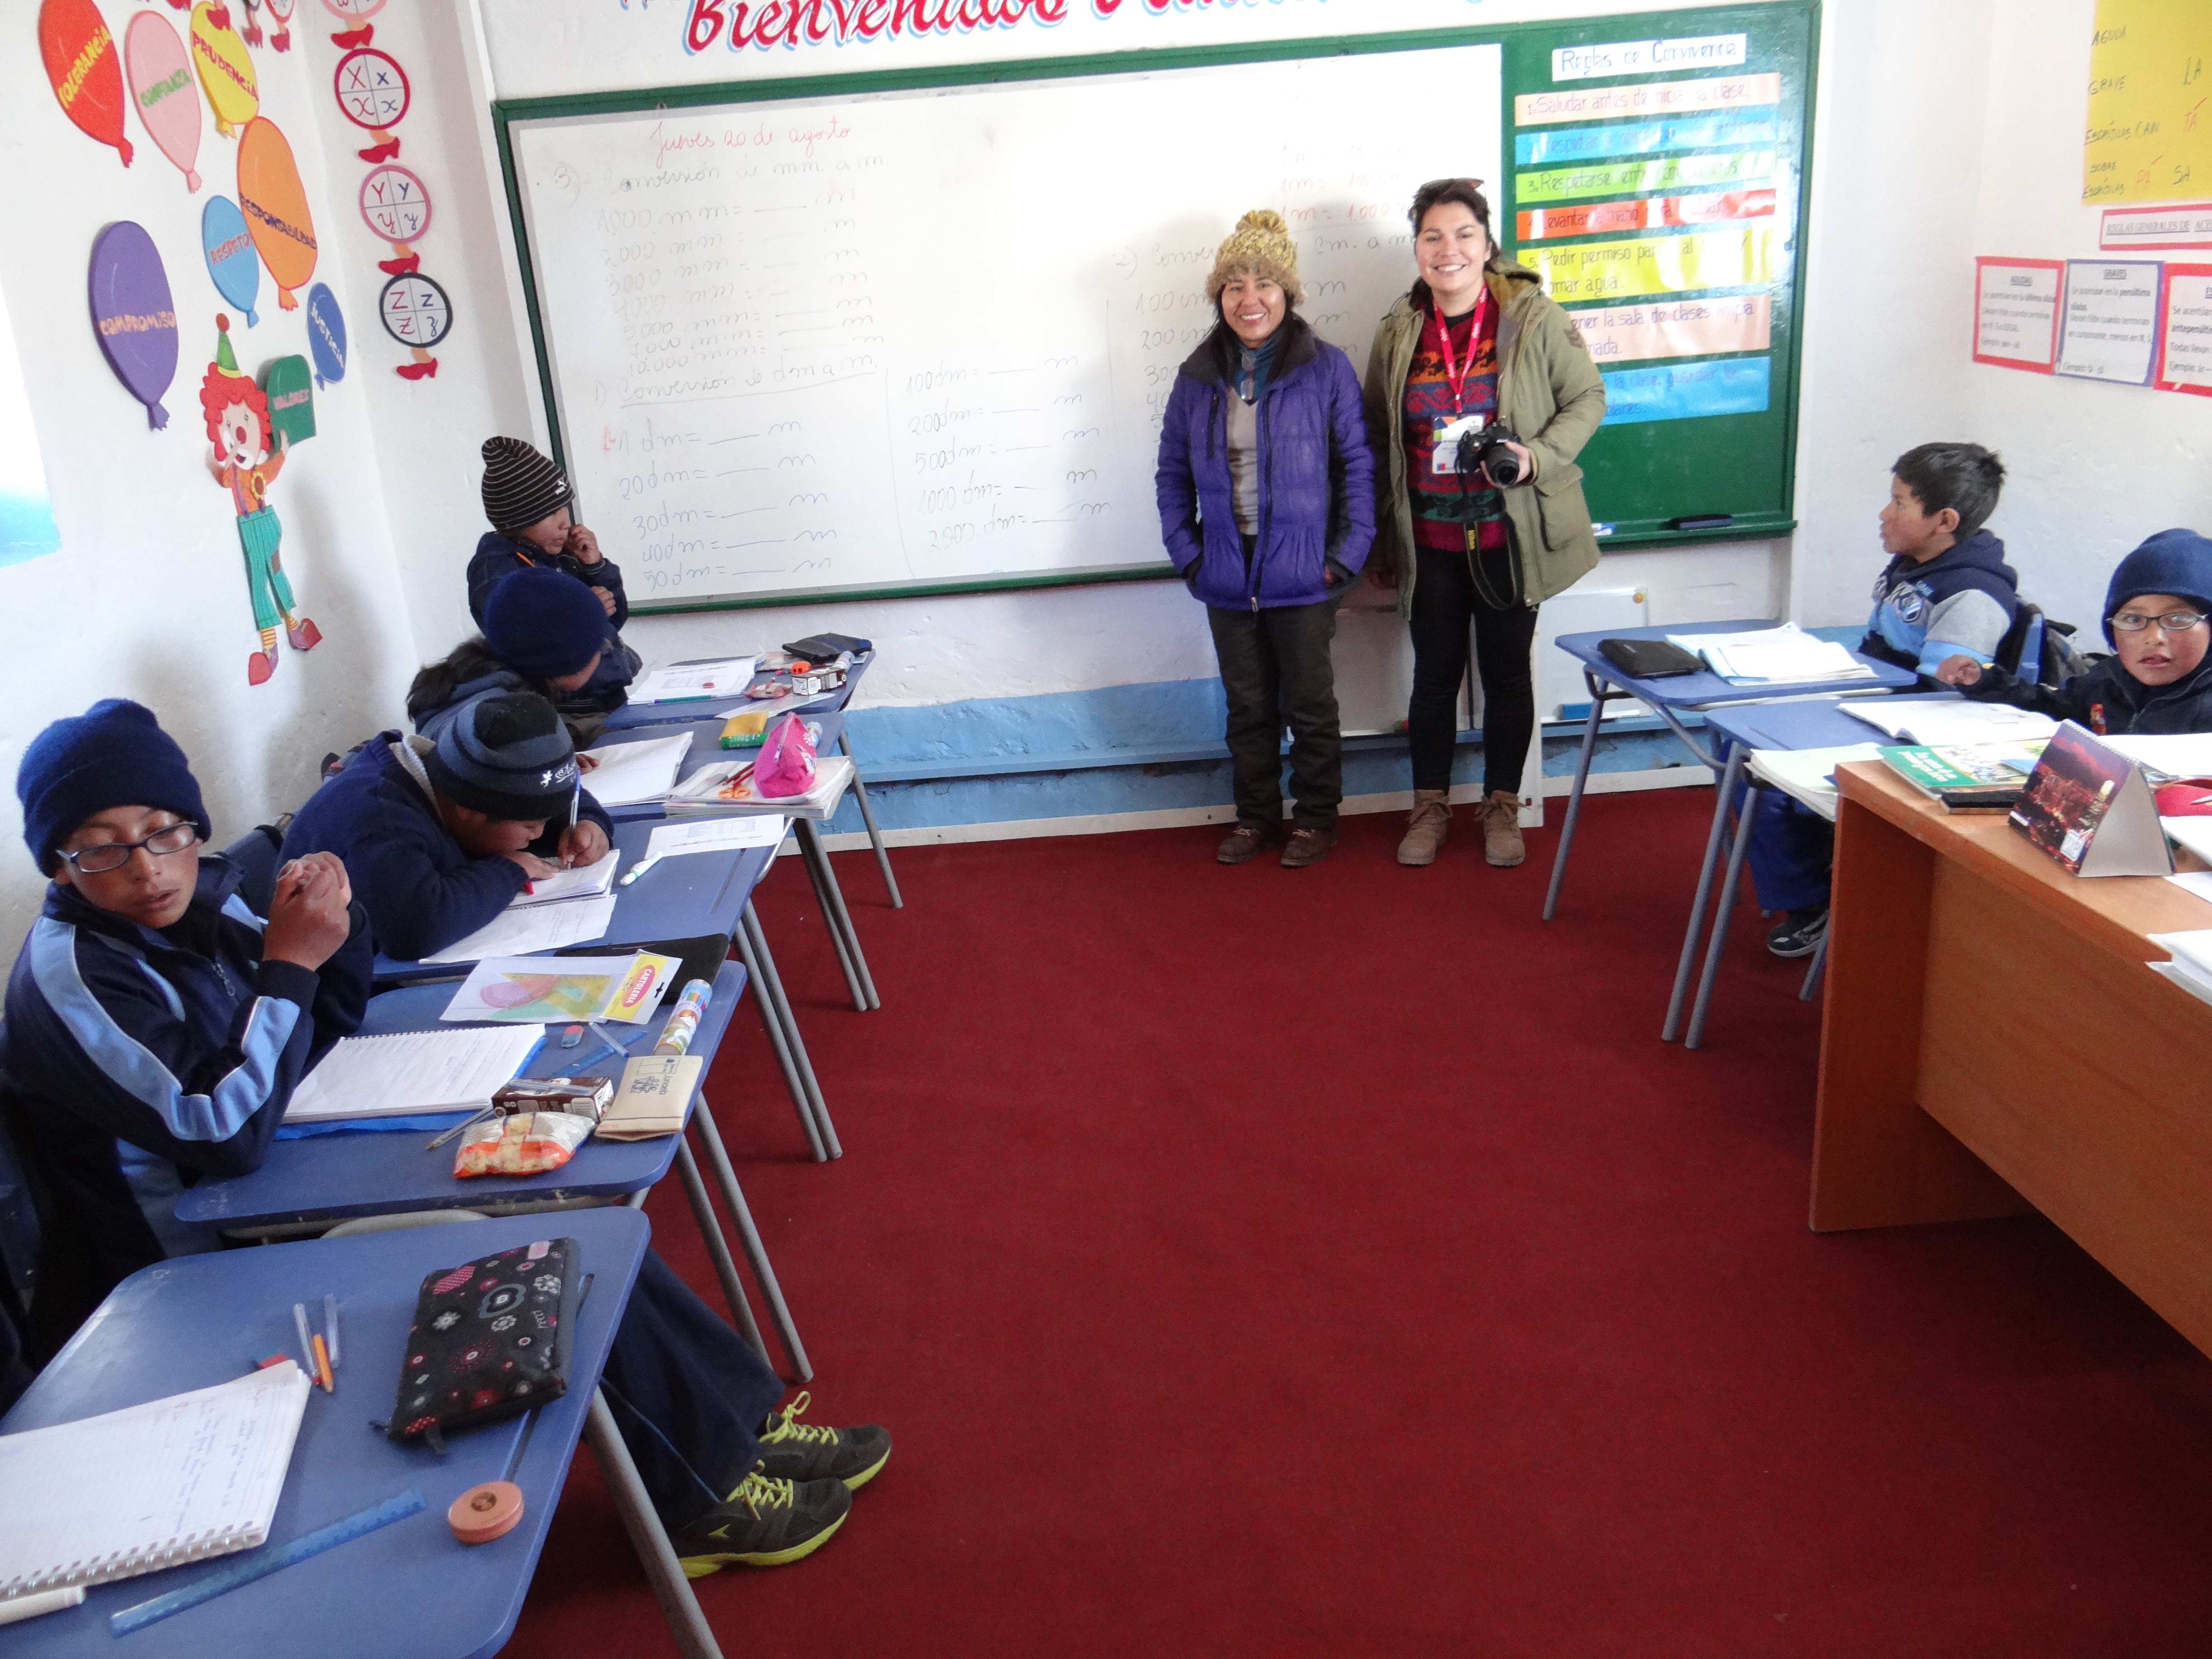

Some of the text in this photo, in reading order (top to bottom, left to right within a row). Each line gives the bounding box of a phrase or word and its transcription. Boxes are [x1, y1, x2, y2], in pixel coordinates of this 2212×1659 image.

[1561, 38, 1737, 76] Reglas de Convivencia
[347, 66, 366, 89] X
[1634, 86, 1648, 106] de
[650, 123, 715, 168] Jueves
[724, 130, 746, 147] 20
[789, 117, 850, 157] agosto
[371, 182, 385, 204] Y
[1544, 208, 1589, 230] evantar
[1581, 247, 1632, 271] permiso
[390, 291, 408, 309] Z
[1603, 309, 1615, 328] la
[1651, 306, 1667, 324] de
[625, 968, 653, 1004] CARTOLERIA
